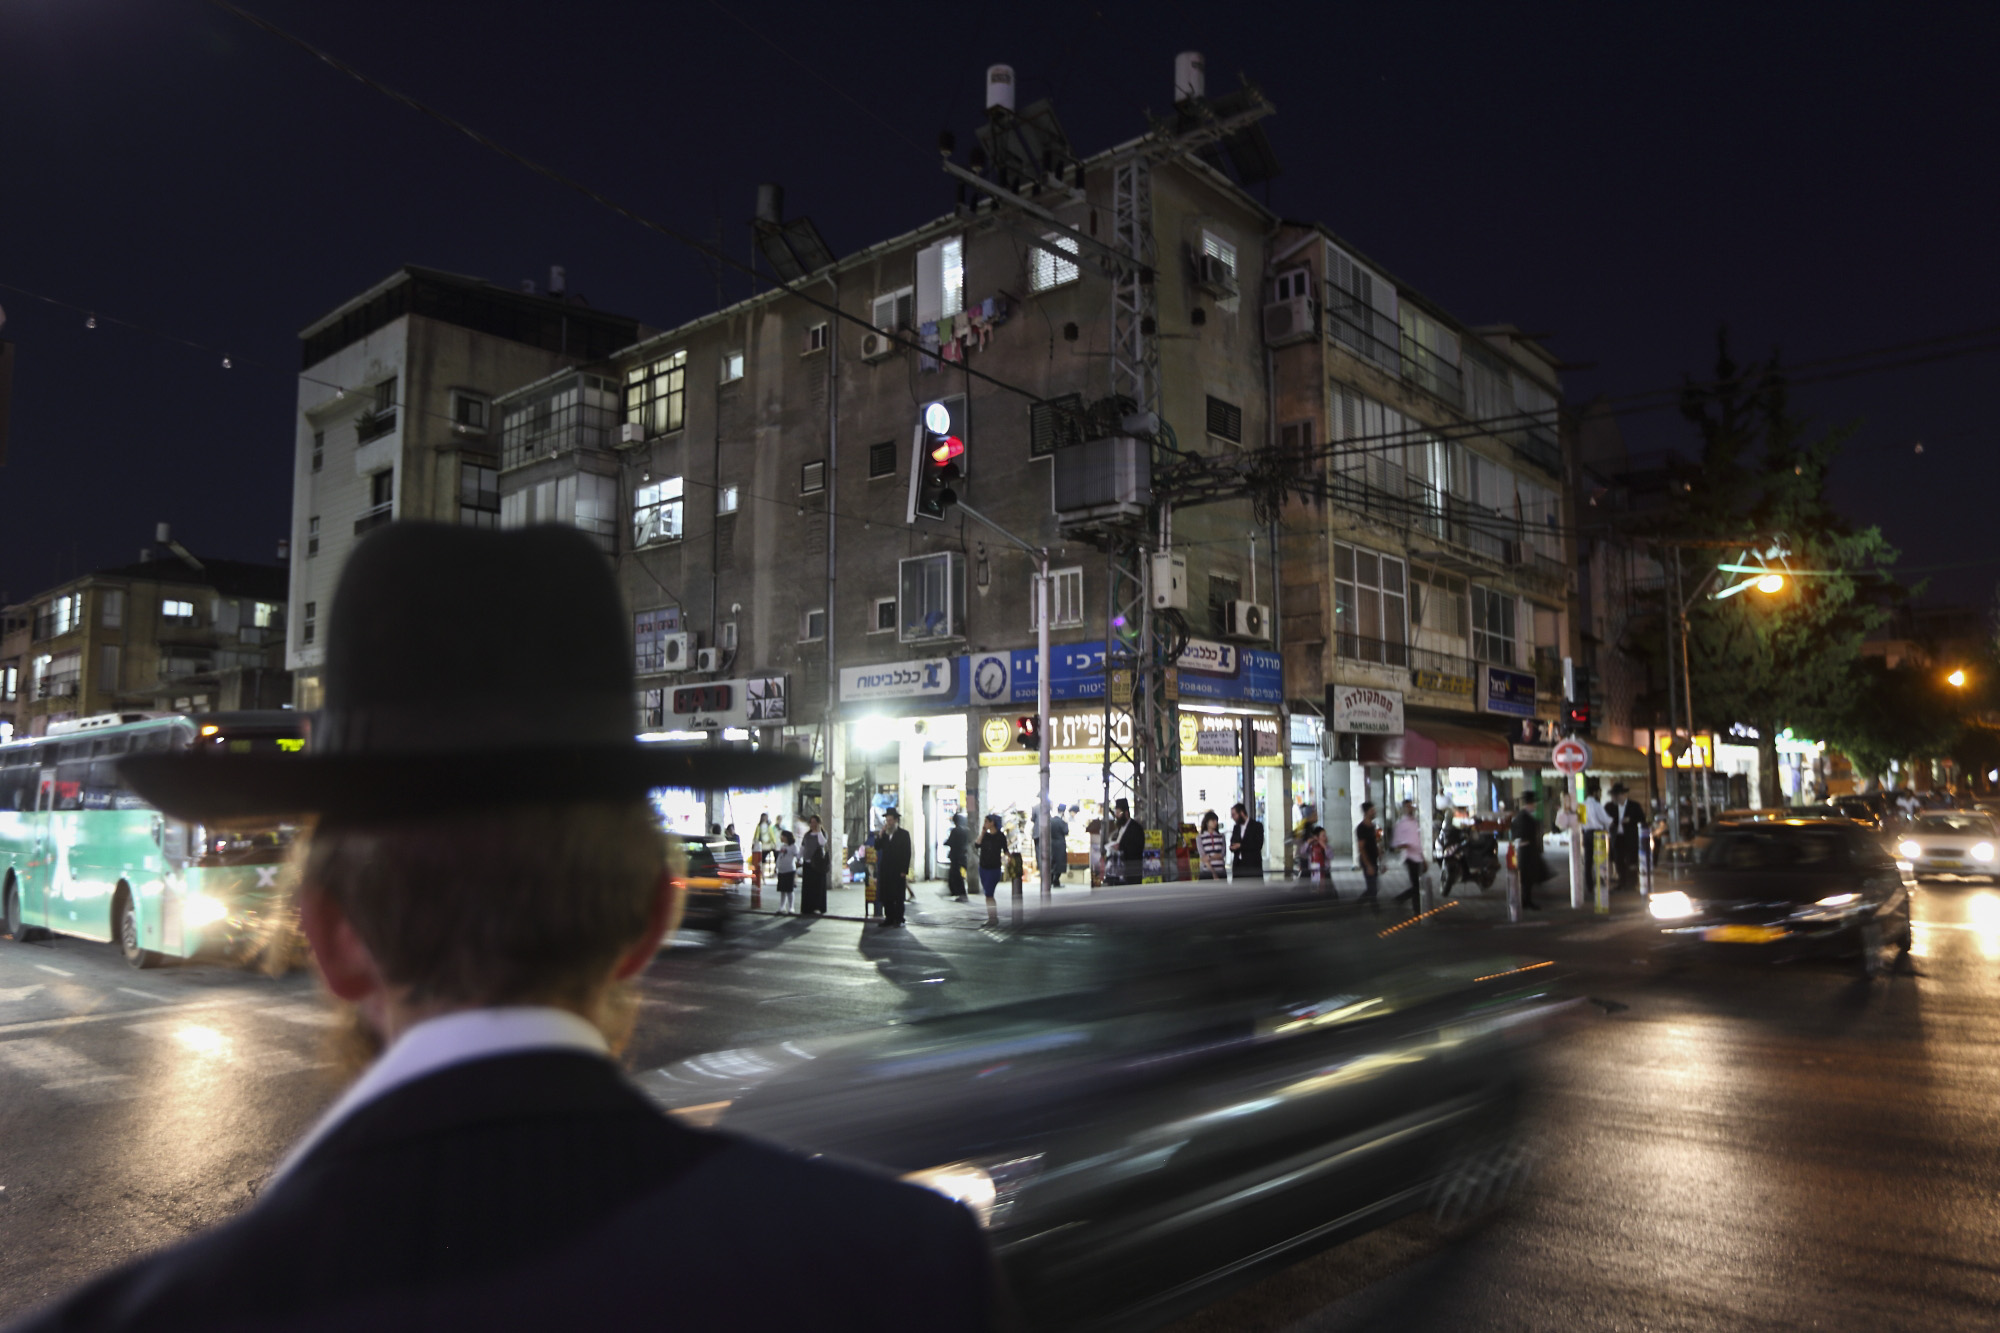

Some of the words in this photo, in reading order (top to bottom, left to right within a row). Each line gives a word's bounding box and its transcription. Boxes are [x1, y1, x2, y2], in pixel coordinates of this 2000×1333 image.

[1243, 652, 1254, 667] לוי
[1256, 657, 1281, 670] מרדכי
[857, 670, 921, 689] כללביטוח
[1344, 688, 1394, 713] ממתקולדה
